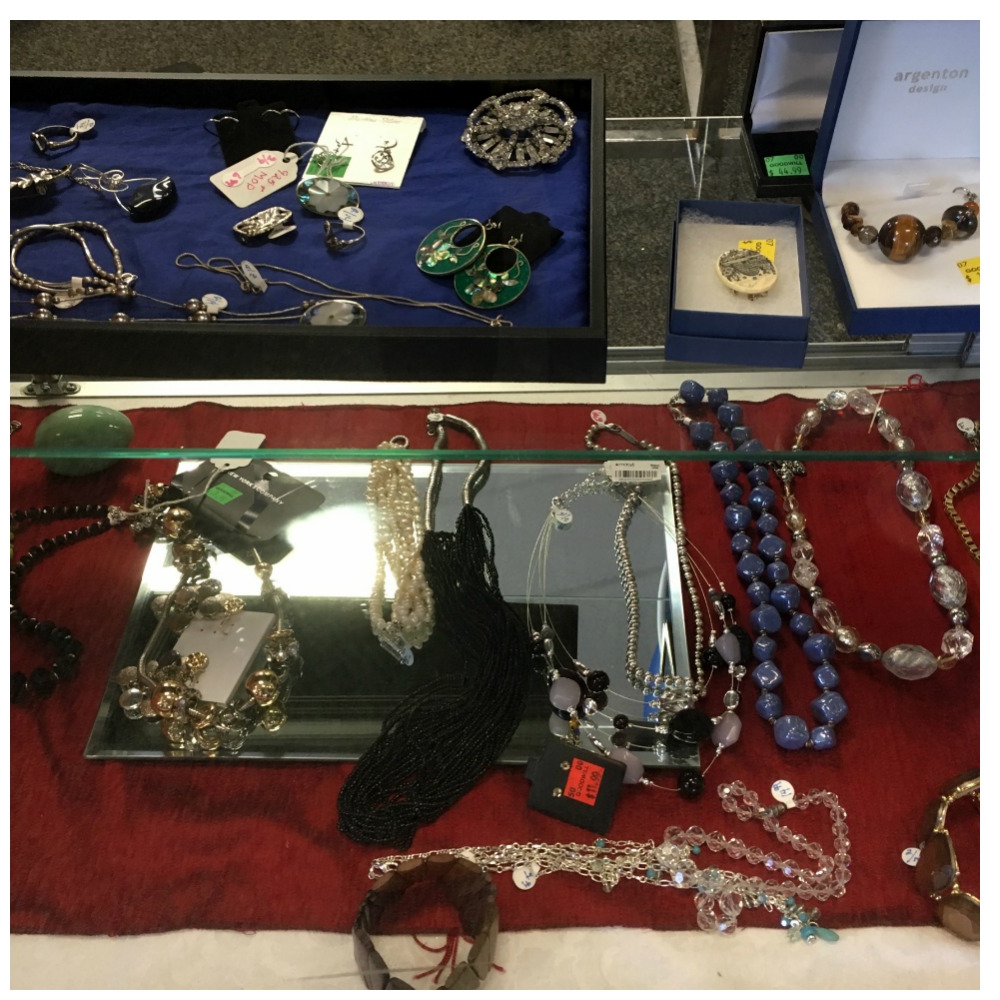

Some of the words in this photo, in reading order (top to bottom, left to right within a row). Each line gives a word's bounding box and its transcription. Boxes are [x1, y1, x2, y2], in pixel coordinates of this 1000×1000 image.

[893, 68, 969, 84] argenton
[908, 84, 948, 94] design
[778, 166, 802, 176] 44.99
